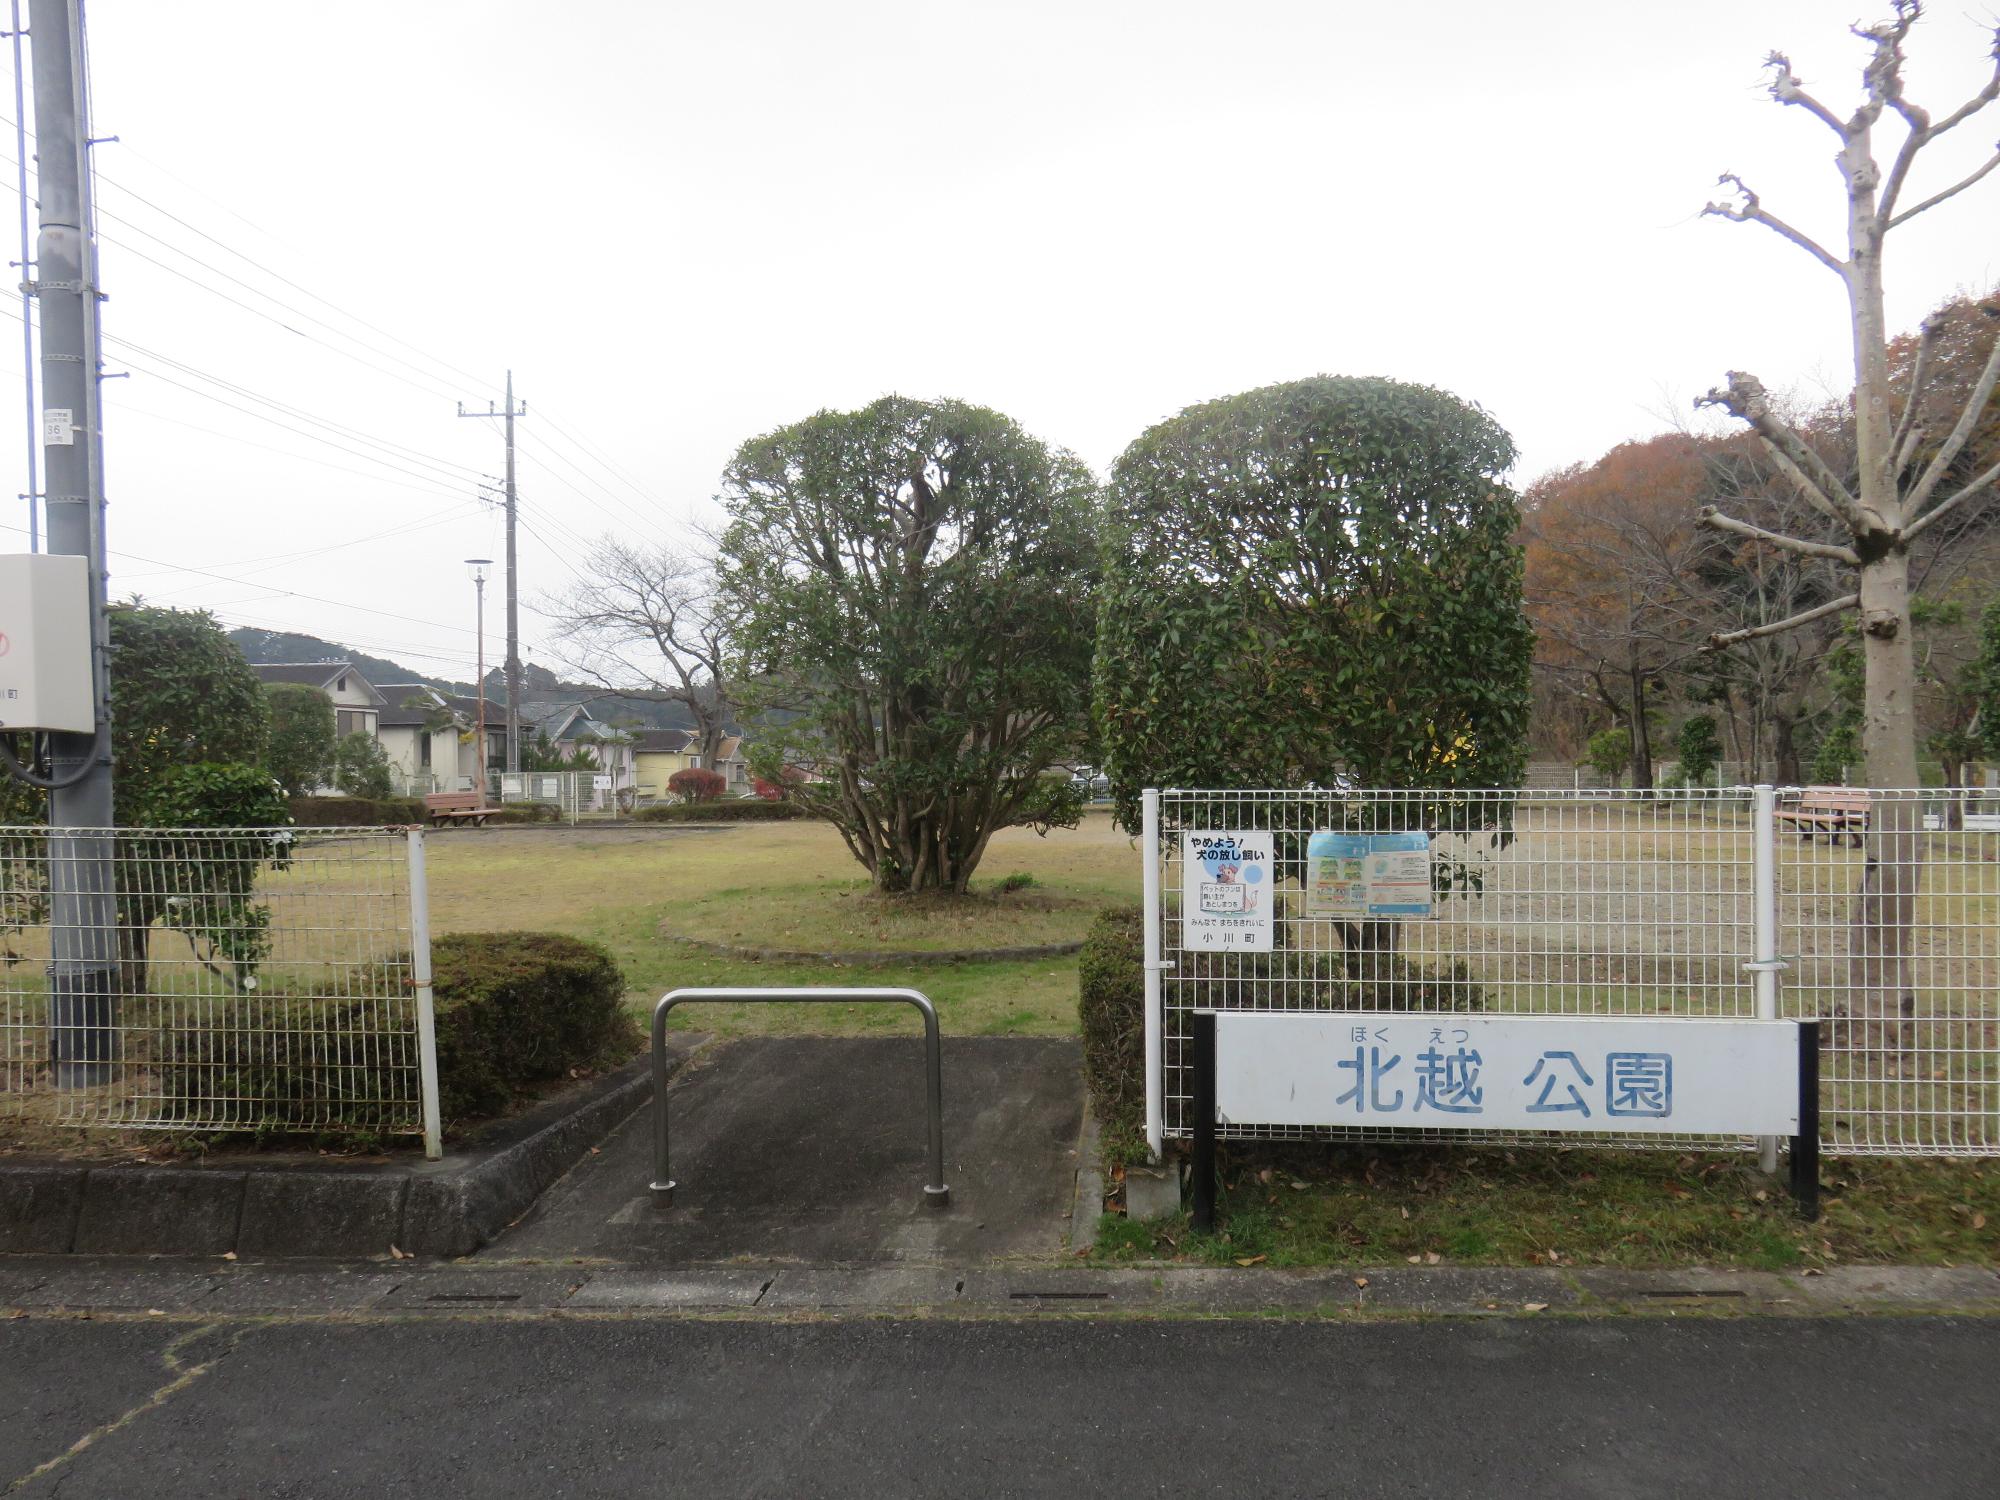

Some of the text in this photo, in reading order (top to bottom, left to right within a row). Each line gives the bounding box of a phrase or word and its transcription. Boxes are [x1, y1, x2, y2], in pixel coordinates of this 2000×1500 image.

[1196, 850, 1265, 861] 犬の放し飼い
